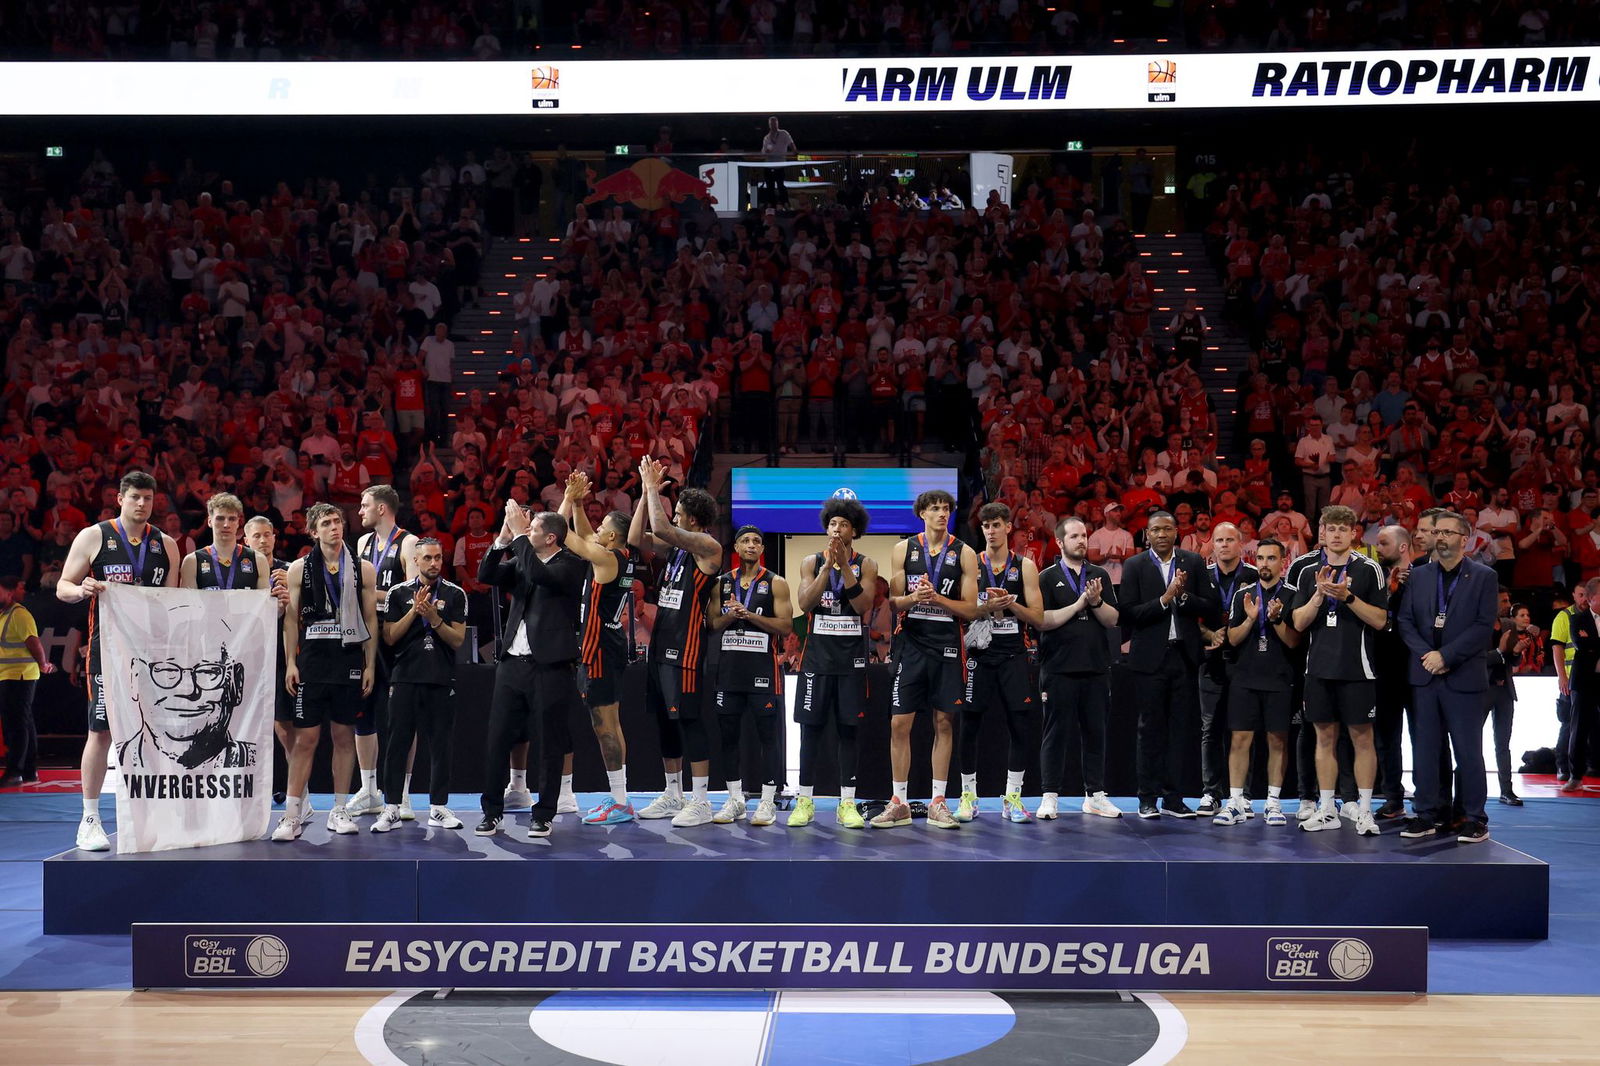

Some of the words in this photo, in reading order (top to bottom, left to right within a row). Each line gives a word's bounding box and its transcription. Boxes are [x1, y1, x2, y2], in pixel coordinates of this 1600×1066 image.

[967, 65, 1072, 102] ULM
[1252, 56, 1591, 97] RATIOPHARM
[537, 99, 554, 108] ulm
[1153, 93, 1170, 102] ulm
[103, 564, 132, 574] LIQUI
[105, 573, 133, 583] MOLY
[151, 566, 164, 585] 13
[381, 569, 393, 587] 14
[940, 578, 955, 596] 21
[803, 678, 814, 712] Allianz
[892, 675, 901, 707] Allianz
[965, 671, 975, 703] Allianz
[296, 686, 305, 719] Allianz
[193, 957, 236, 974] BBL
[344, 940, 622, 973] EASYCREDIT
[627, 940, 914, 974] BASKETBALL
[924, 941, 1211, 975] BUNDESLIGA
[1274, 959, 1319, 977] BBL
